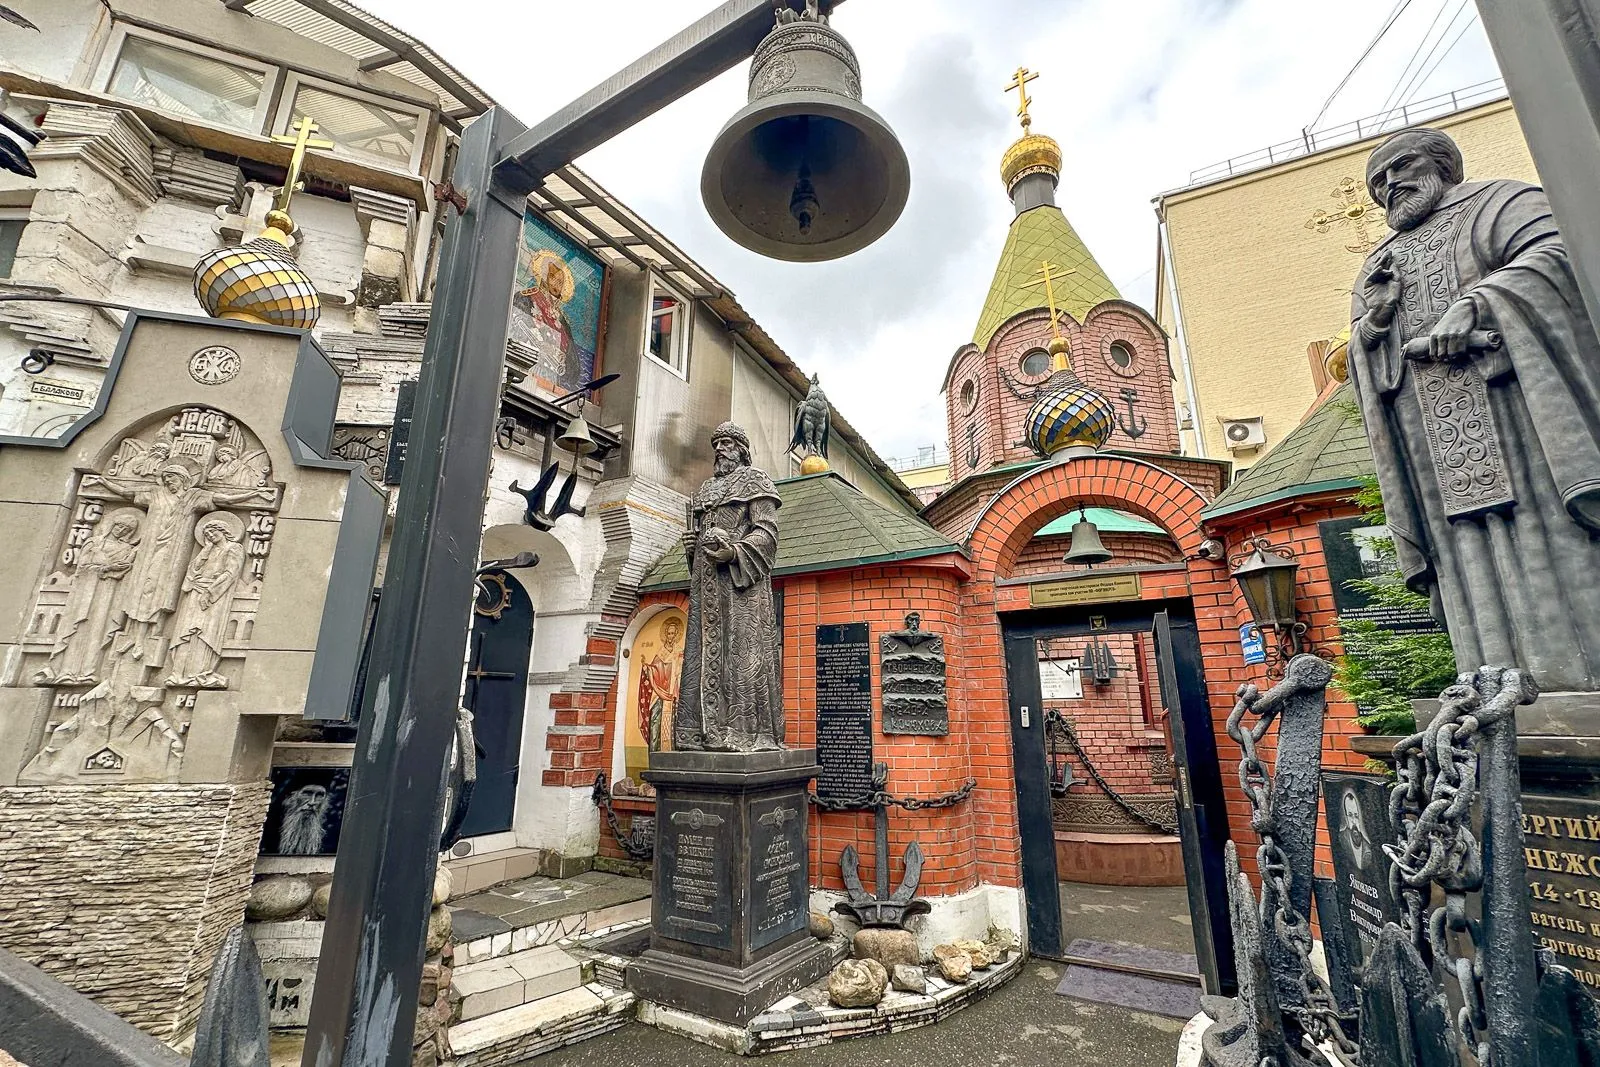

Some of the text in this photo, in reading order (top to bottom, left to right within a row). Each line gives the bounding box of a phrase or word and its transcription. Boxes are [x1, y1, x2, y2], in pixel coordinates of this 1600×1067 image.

[886, 662, 941, 676] ТВОРЧЕСКАЯ
[1349, 873, 1379, 899] Яковлев
[1350, 893, 1383, 922] Александр
